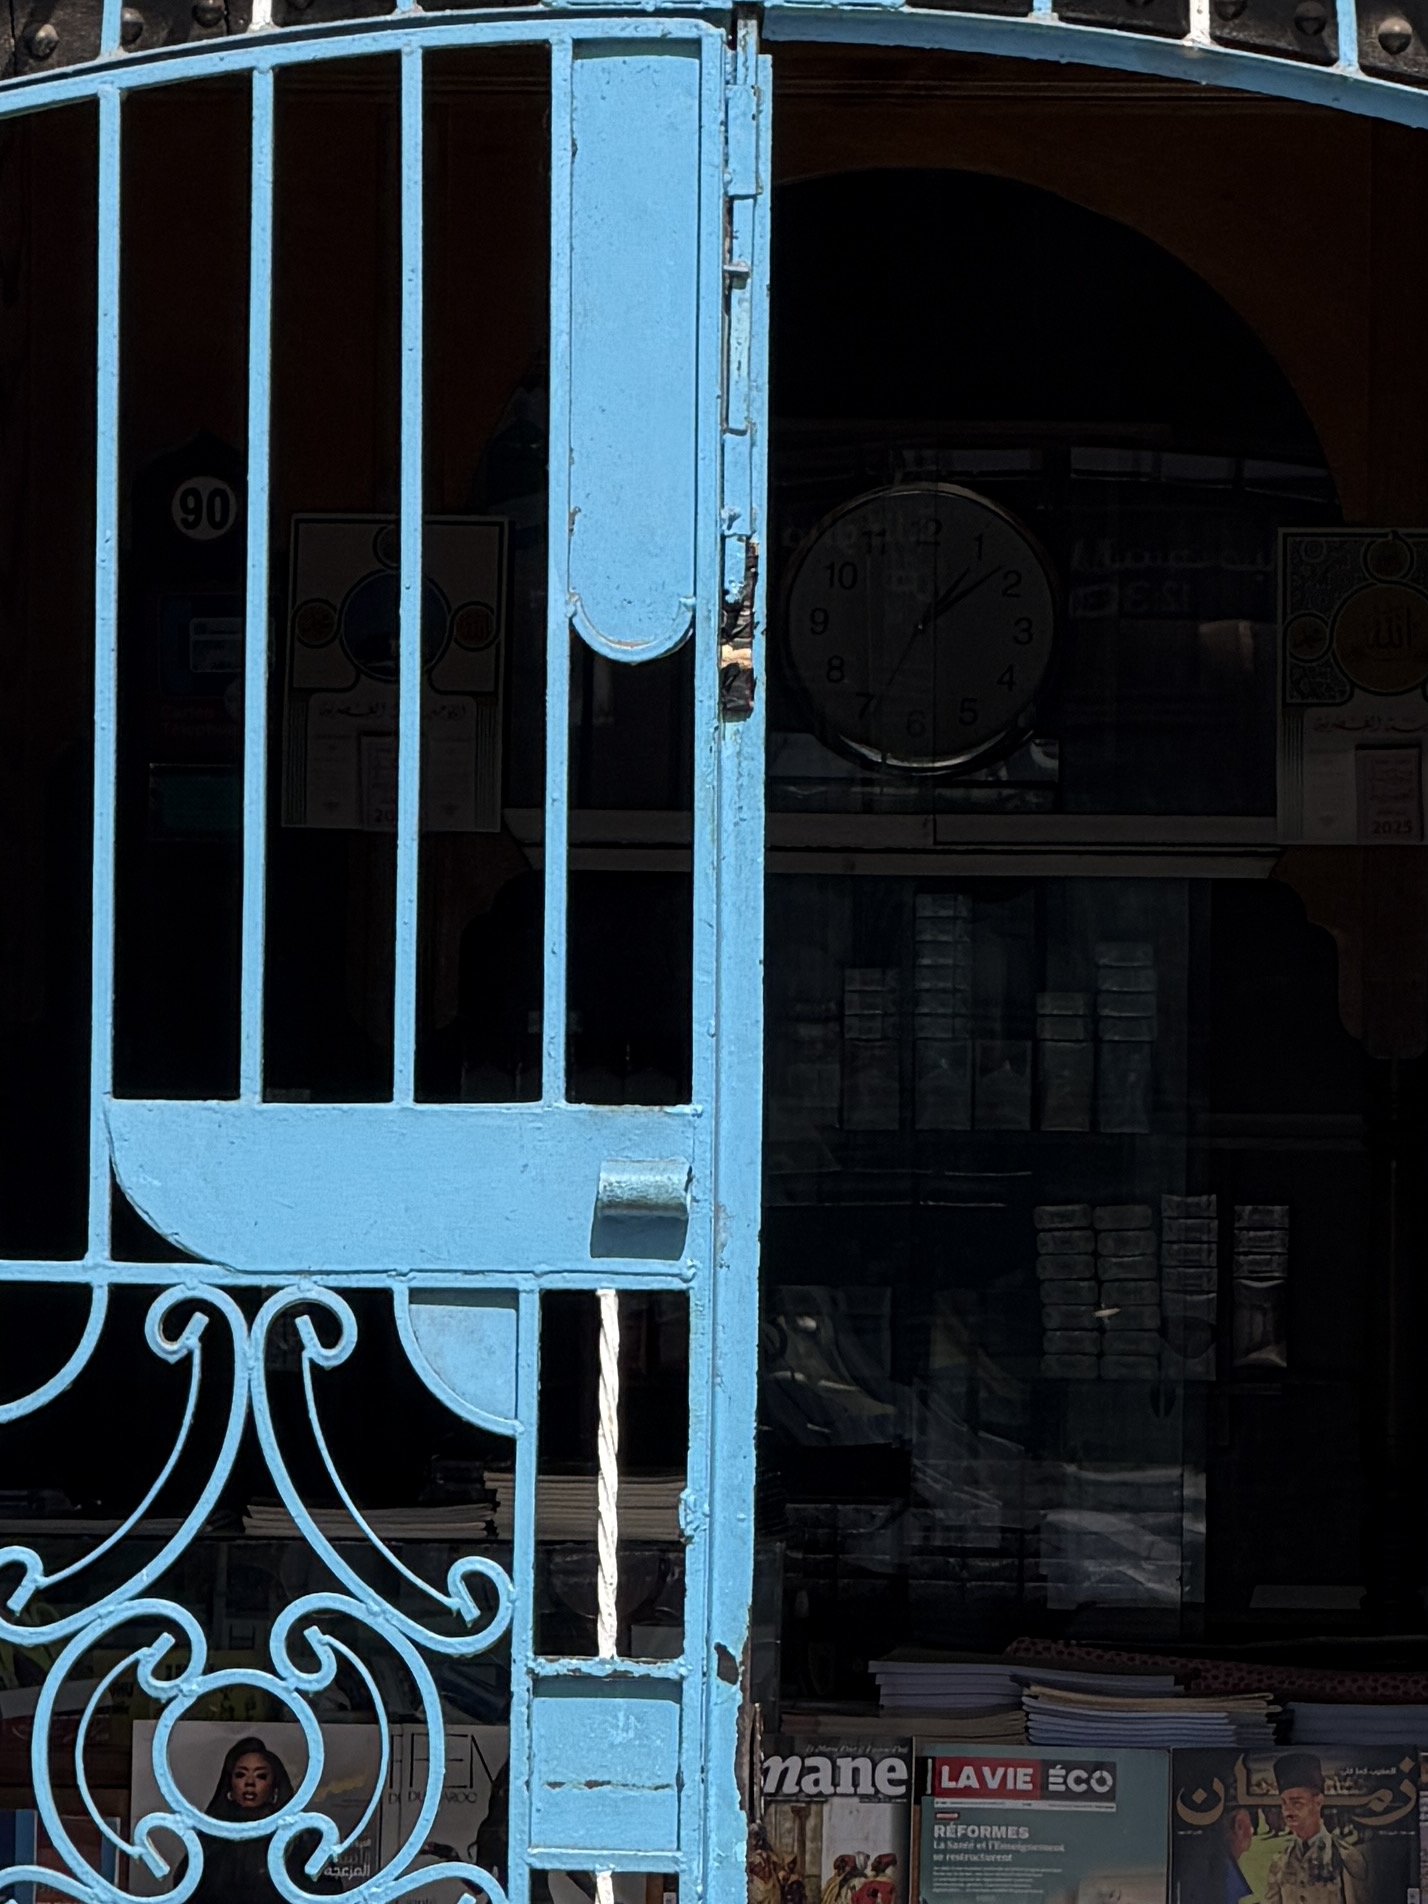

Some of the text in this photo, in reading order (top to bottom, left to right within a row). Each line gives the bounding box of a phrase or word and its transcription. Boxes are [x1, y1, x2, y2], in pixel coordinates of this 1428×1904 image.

[179, 487, 230, 530] 90
[862, 528, 887, 555] 11
[972, 533, 984, 561] 1
[825, 561, 859, 591] 10
[1002, 570, 1023, 598] 2
[809, 607, 830, 635] 9
[1013, 616, 1034, 645] 3
[826, 655, 846, 684] 8
[996, 664, 1017, 692] 4
[855, 692, 875, 720] 7
[958, 697, 979, 726] 5
[906, 709, 927, 736] 6
[1372, 819, 1413, 835] 2025
[762, 1755, 909, 1797] mane
[941, 1764, 1114, 1793] LA VIE ÉCO
[933, 1821, 1030, 1840] RÉFORMES
